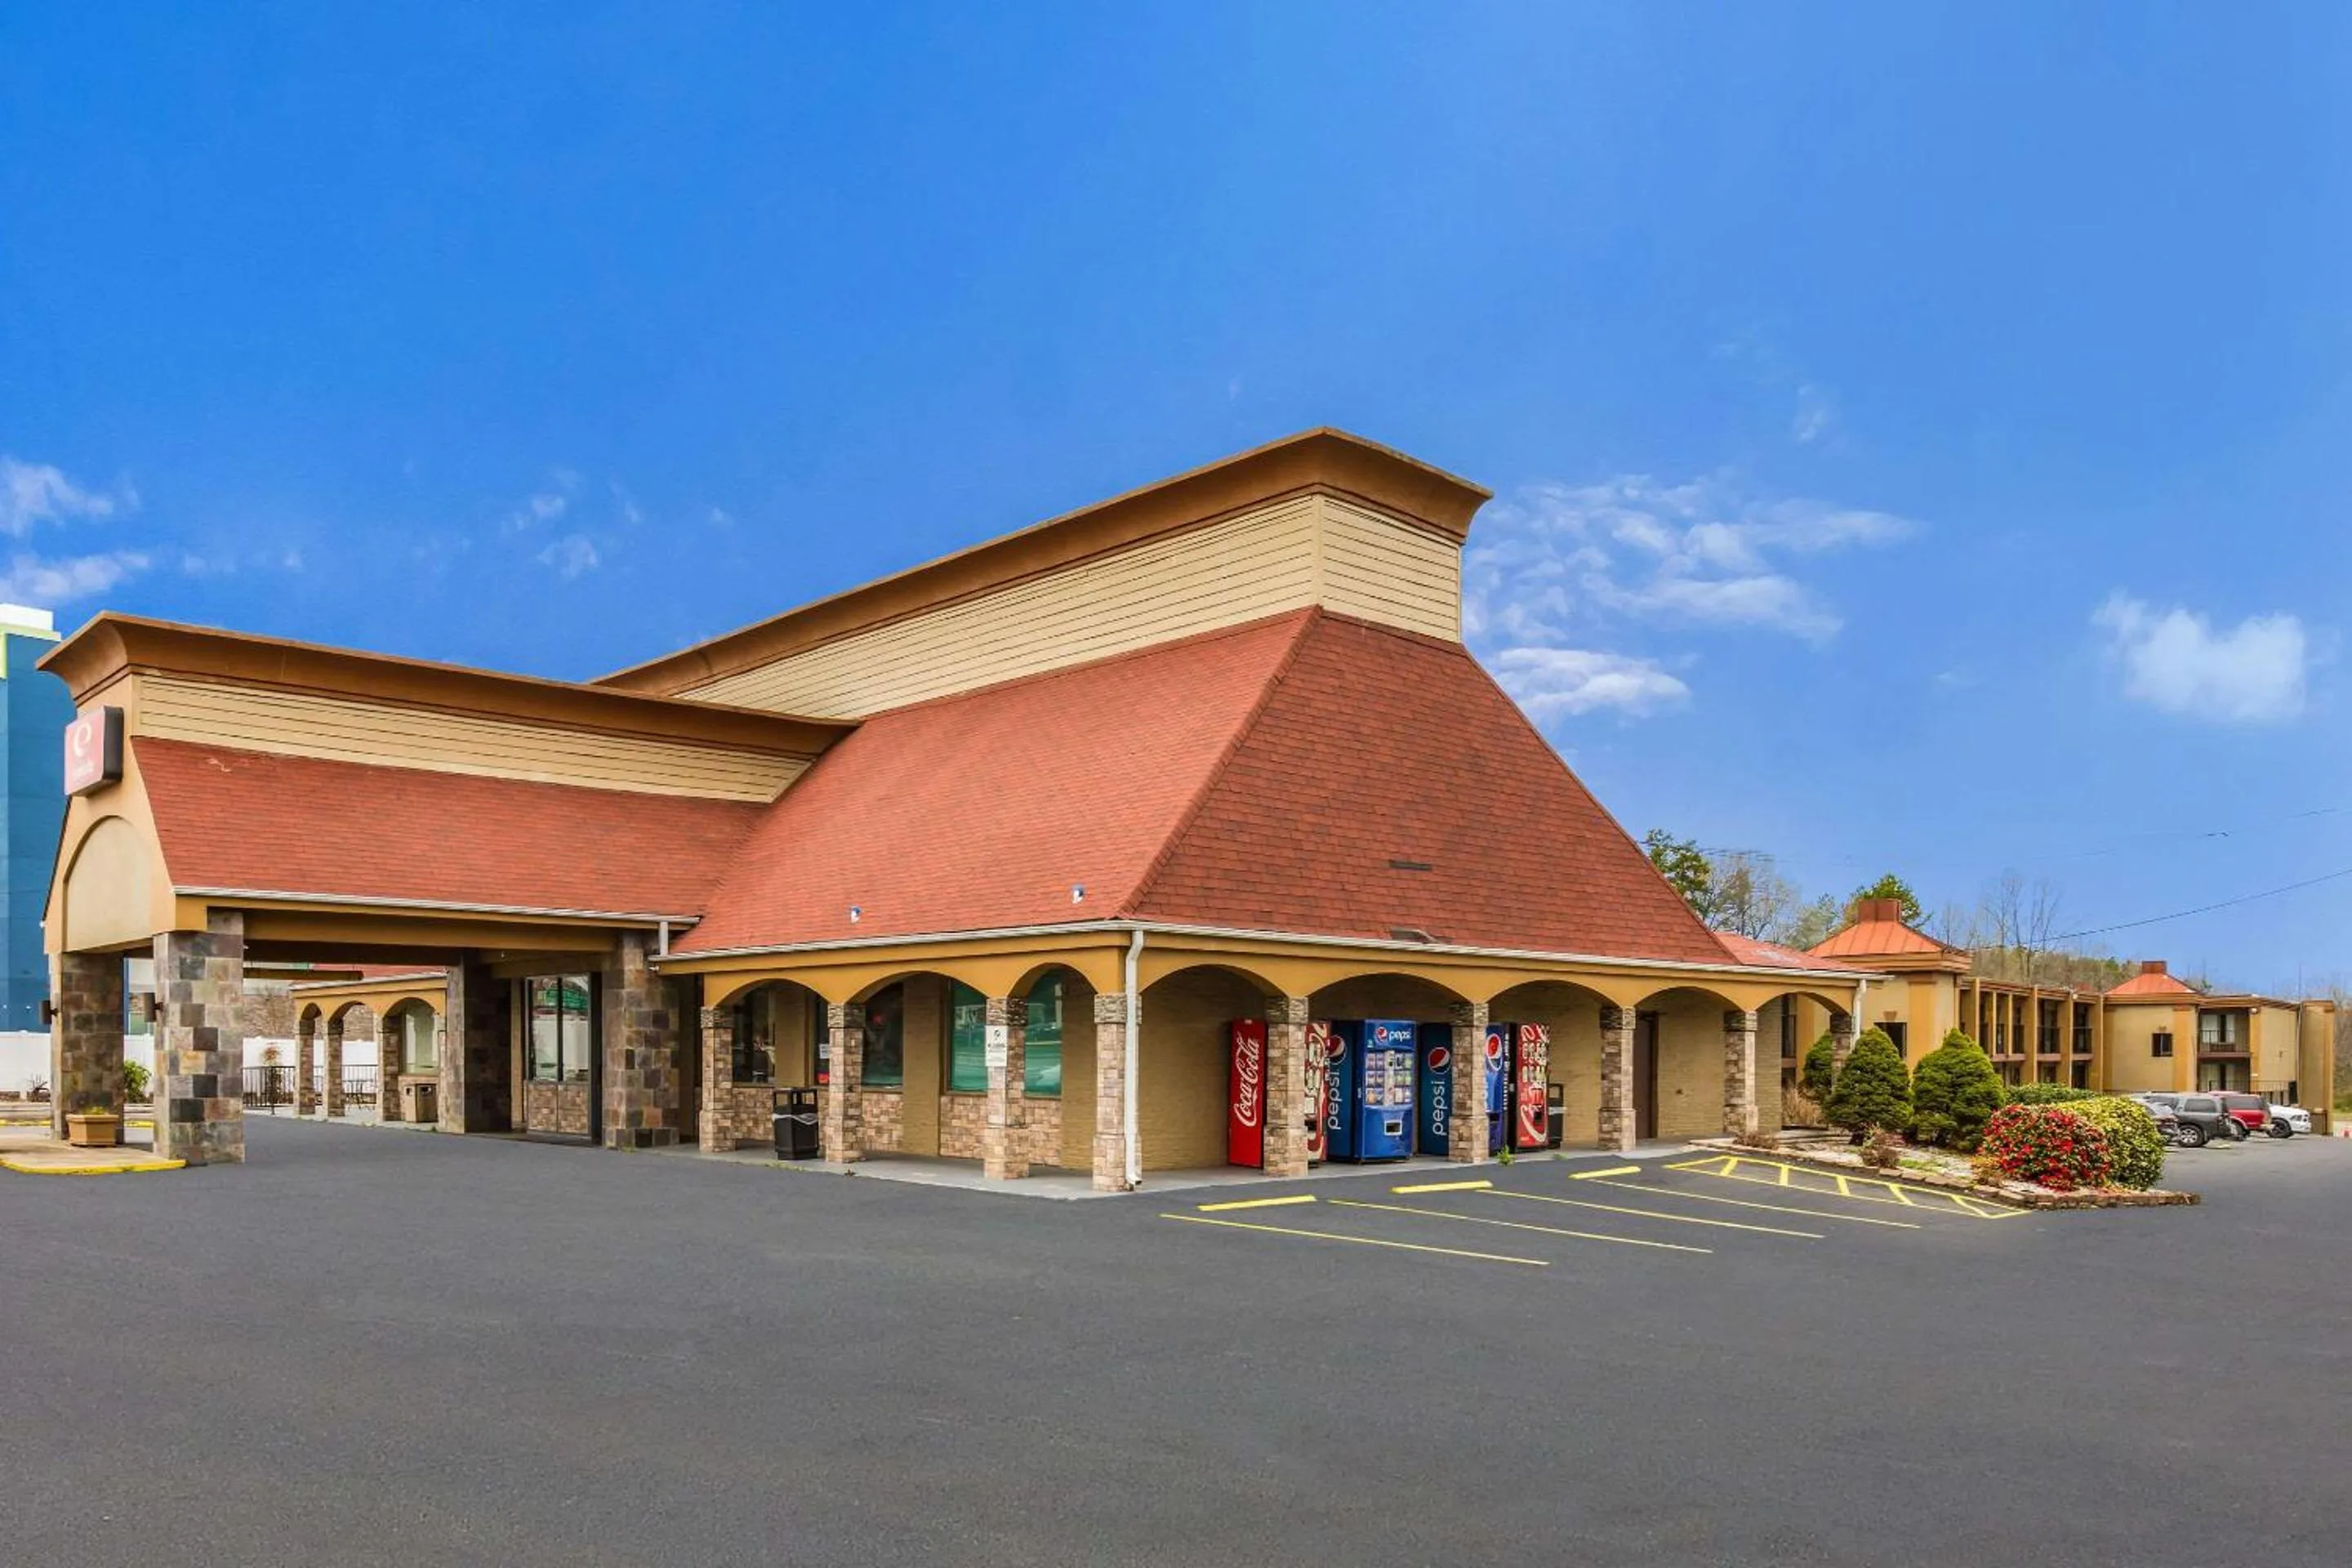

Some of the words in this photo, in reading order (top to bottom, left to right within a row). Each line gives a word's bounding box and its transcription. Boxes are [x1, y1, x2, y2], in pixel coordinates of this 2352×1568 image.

[1388, 1030, 1411, 1042] pepsi
[1328, 1071, 1342, 1129] pepsi
[1432, 1080, 1447, 1136] pepsi
